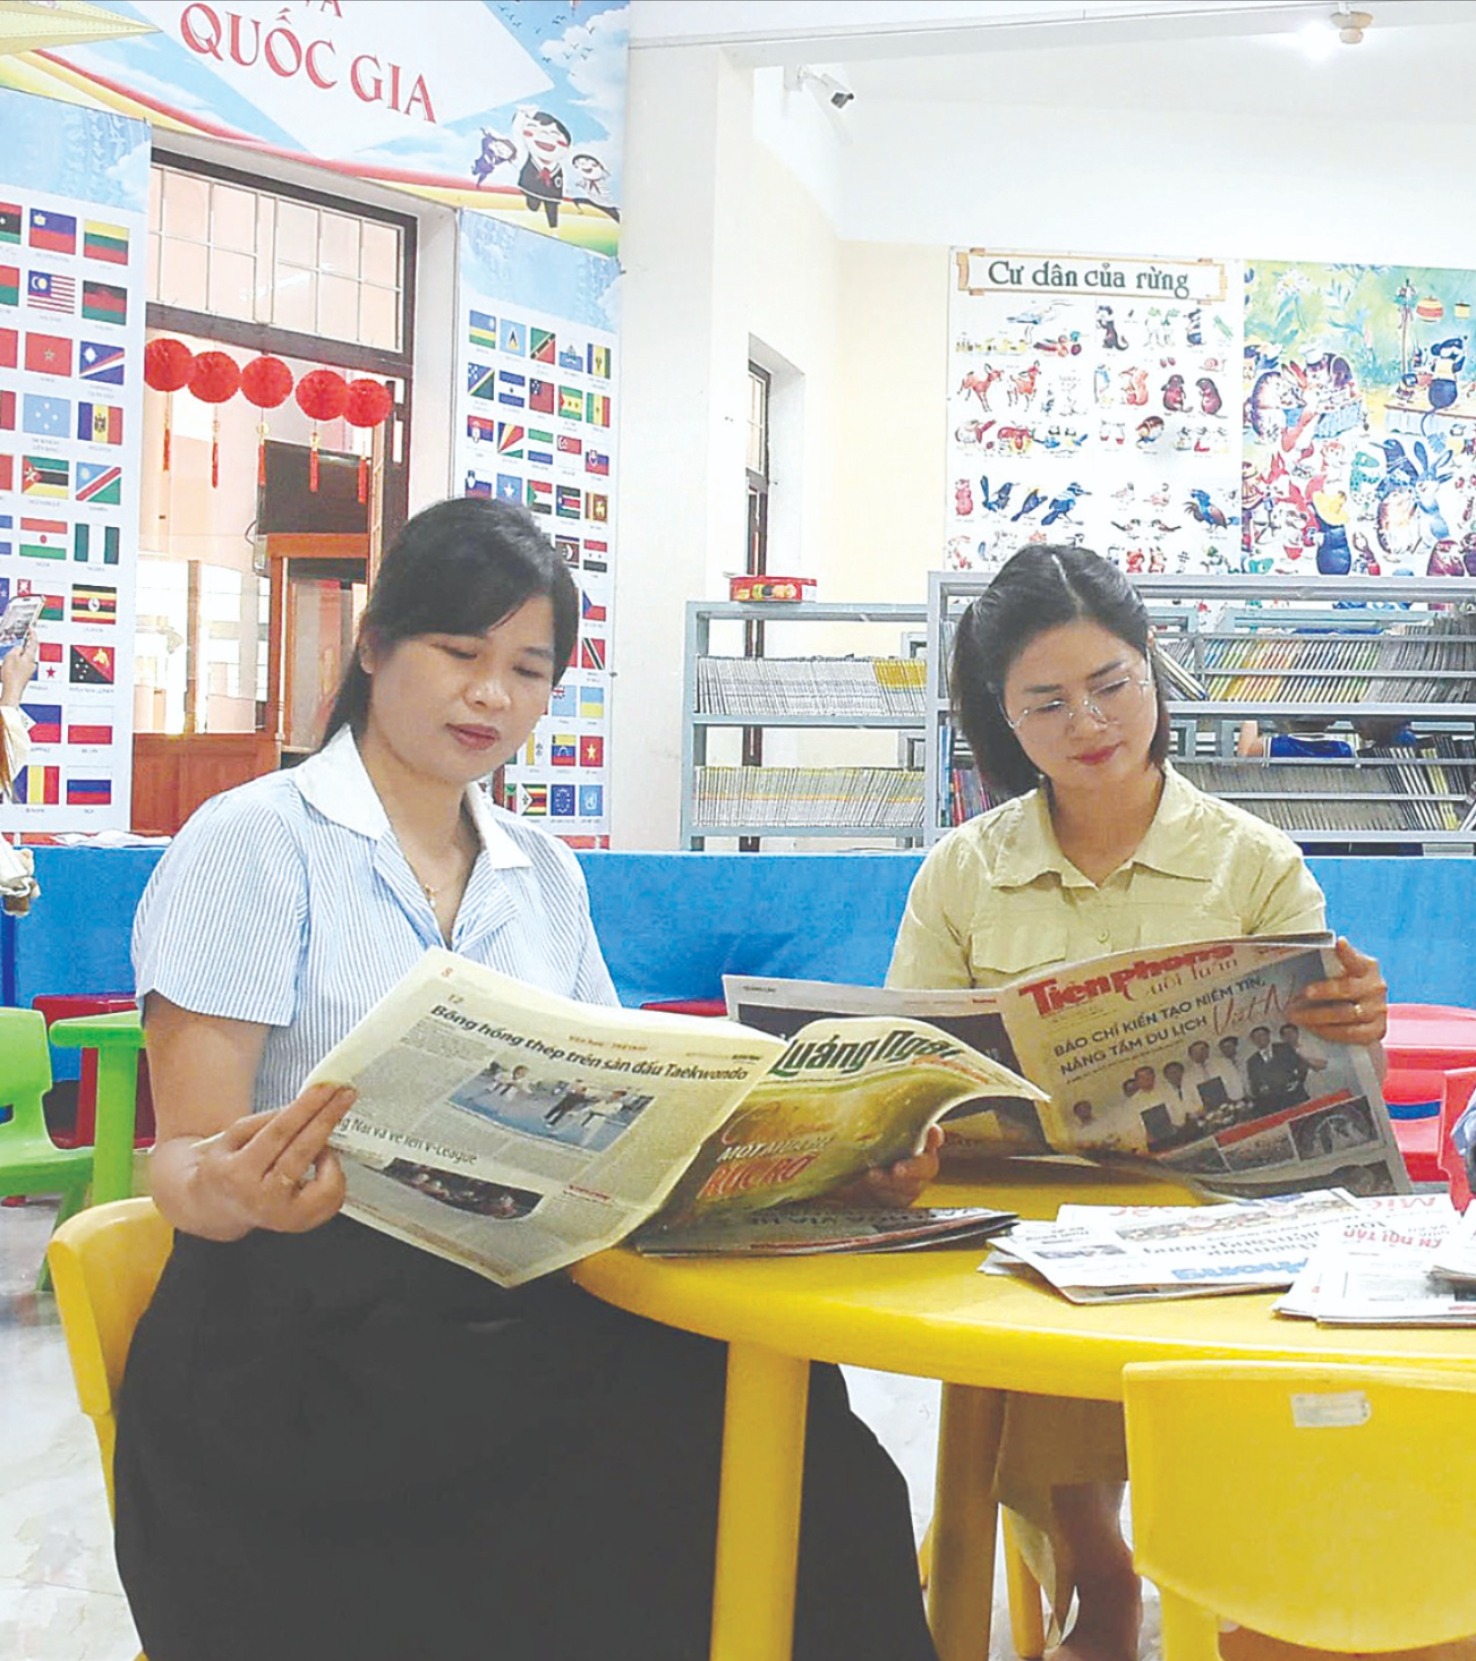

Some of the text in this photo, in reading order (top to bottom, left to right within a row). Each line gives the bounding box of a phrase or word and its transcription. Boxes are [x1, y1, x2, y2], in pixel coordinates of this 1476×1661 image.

[180, 3, 437, 124] QUỐC GIA
[988, 261, 1190, 300] Cư dân của rừng
[430, 1004, 478, 1035] Bông
[566, 1050, 601, 1068] trên
[665, 1063, 749, 1080] Taekwondo
[1054, 1034, 1088, 1058] BÁO
[1161, 1000, 1192, 1021] TẠO
[1147, 1028, 1171, 1046] DU
